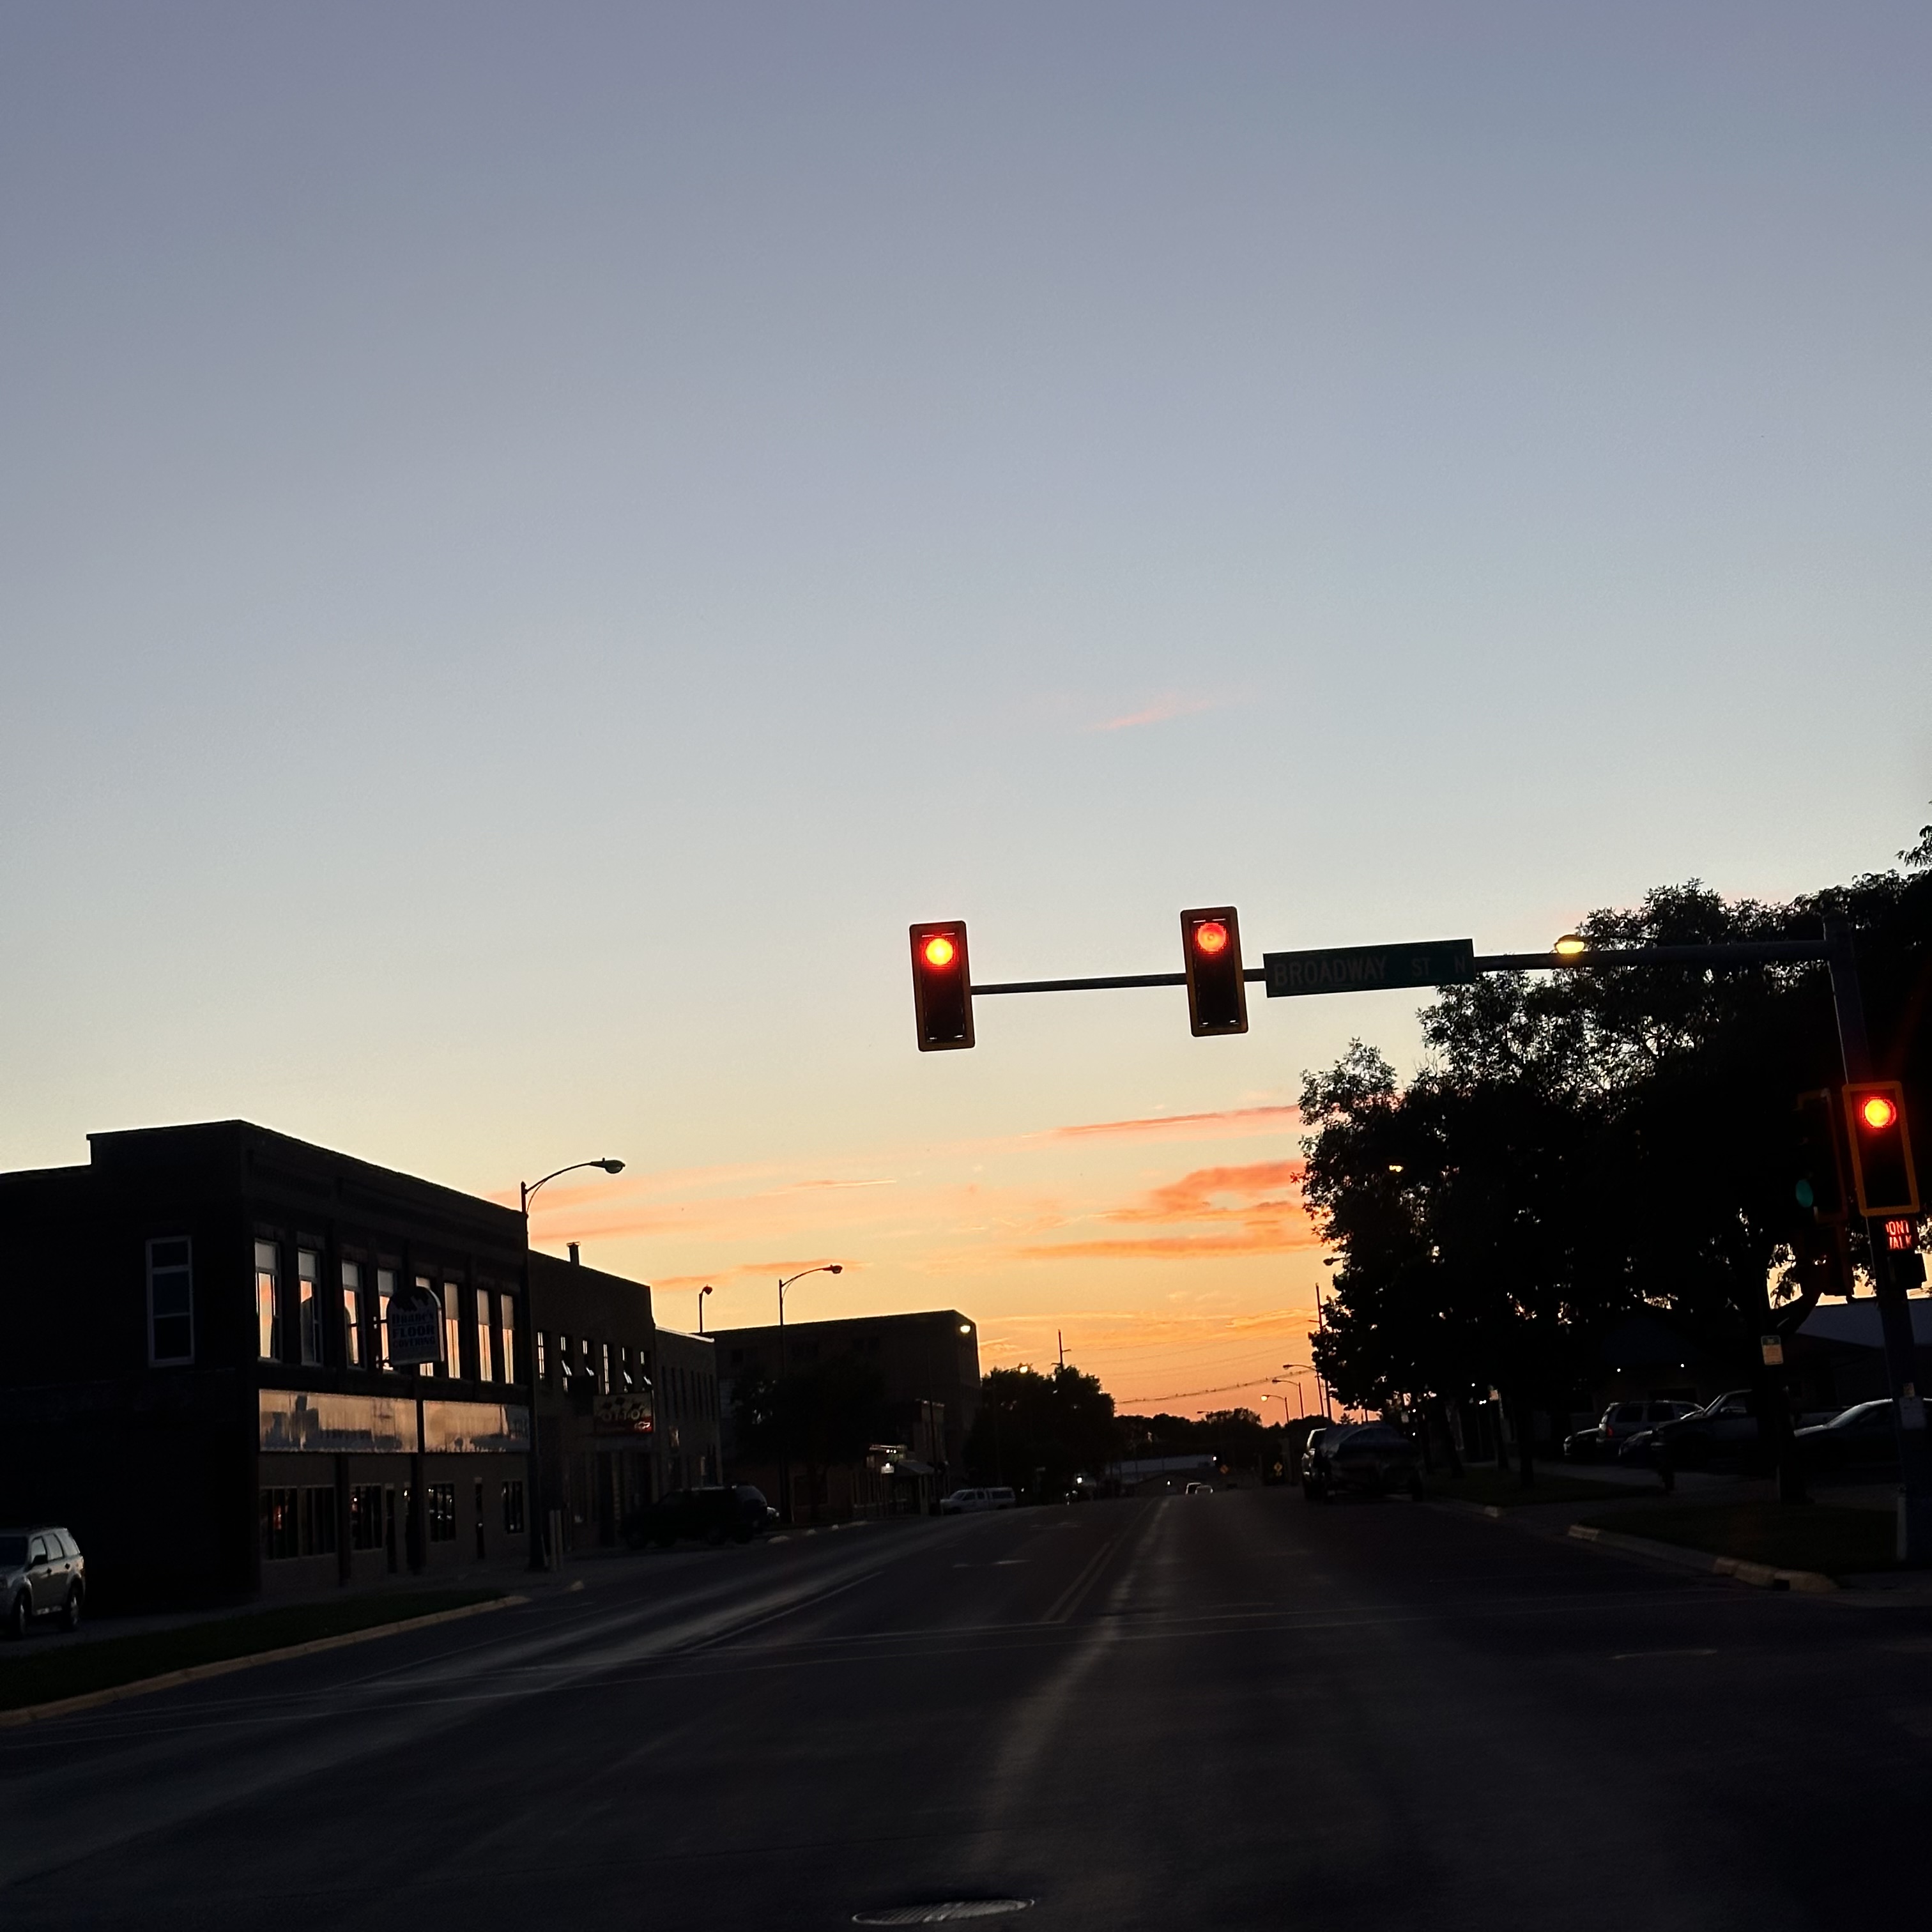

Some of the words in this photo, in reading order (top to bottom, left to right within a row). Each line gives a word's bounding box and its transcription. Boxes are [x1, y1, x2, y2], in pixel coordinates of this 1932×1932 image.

[1273, 955, 1387, 987] BROADWAY
[1411, 958, 1430, 977] ST
[1454, 955, 1466, 974] N
[1889, 1235, 1912, 1250] ALK
[393, 1324, 435, 1338] FLOOR
